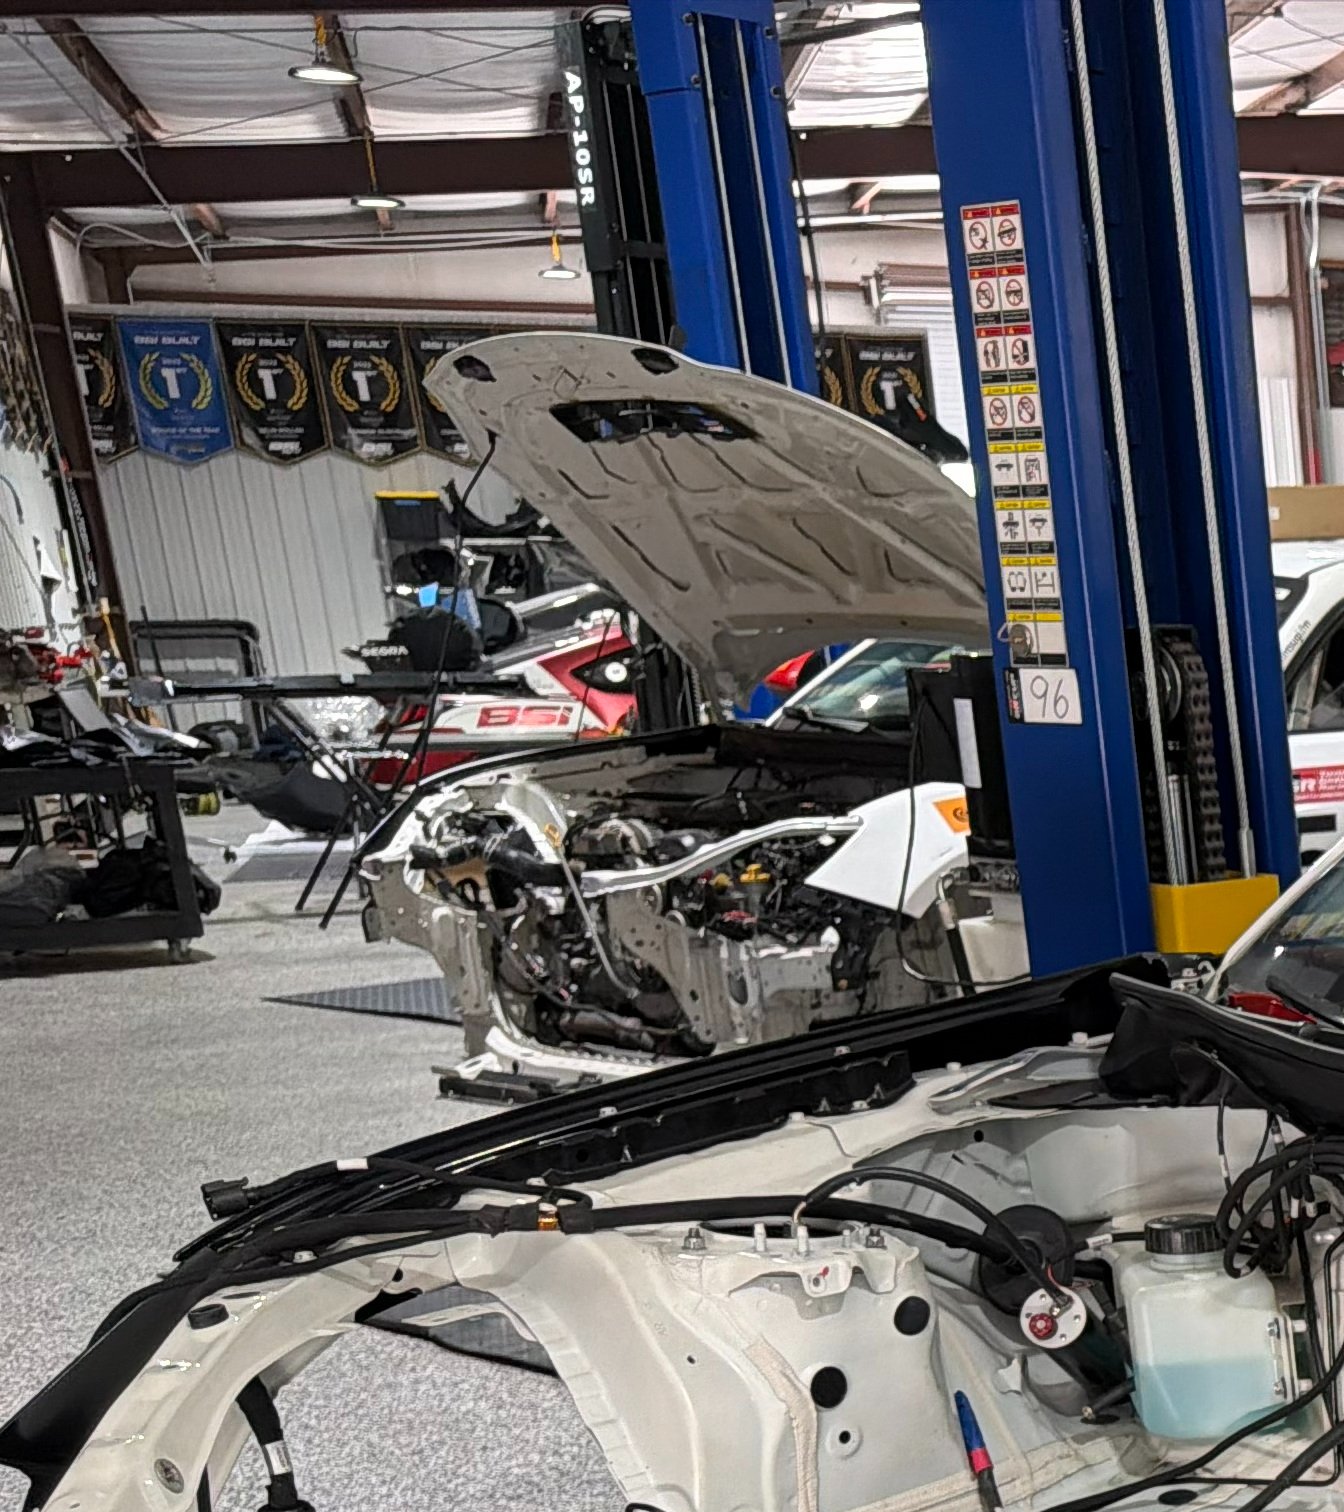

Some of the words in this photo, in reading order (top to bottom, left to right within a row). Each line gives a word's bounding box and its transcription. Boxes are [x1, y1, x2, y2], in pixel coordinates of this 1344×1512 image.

[564, 71, 596, 207] AP-10SR
[475, 705, 574, 729] BSI
[1029, 674, 1070, 720] 96
